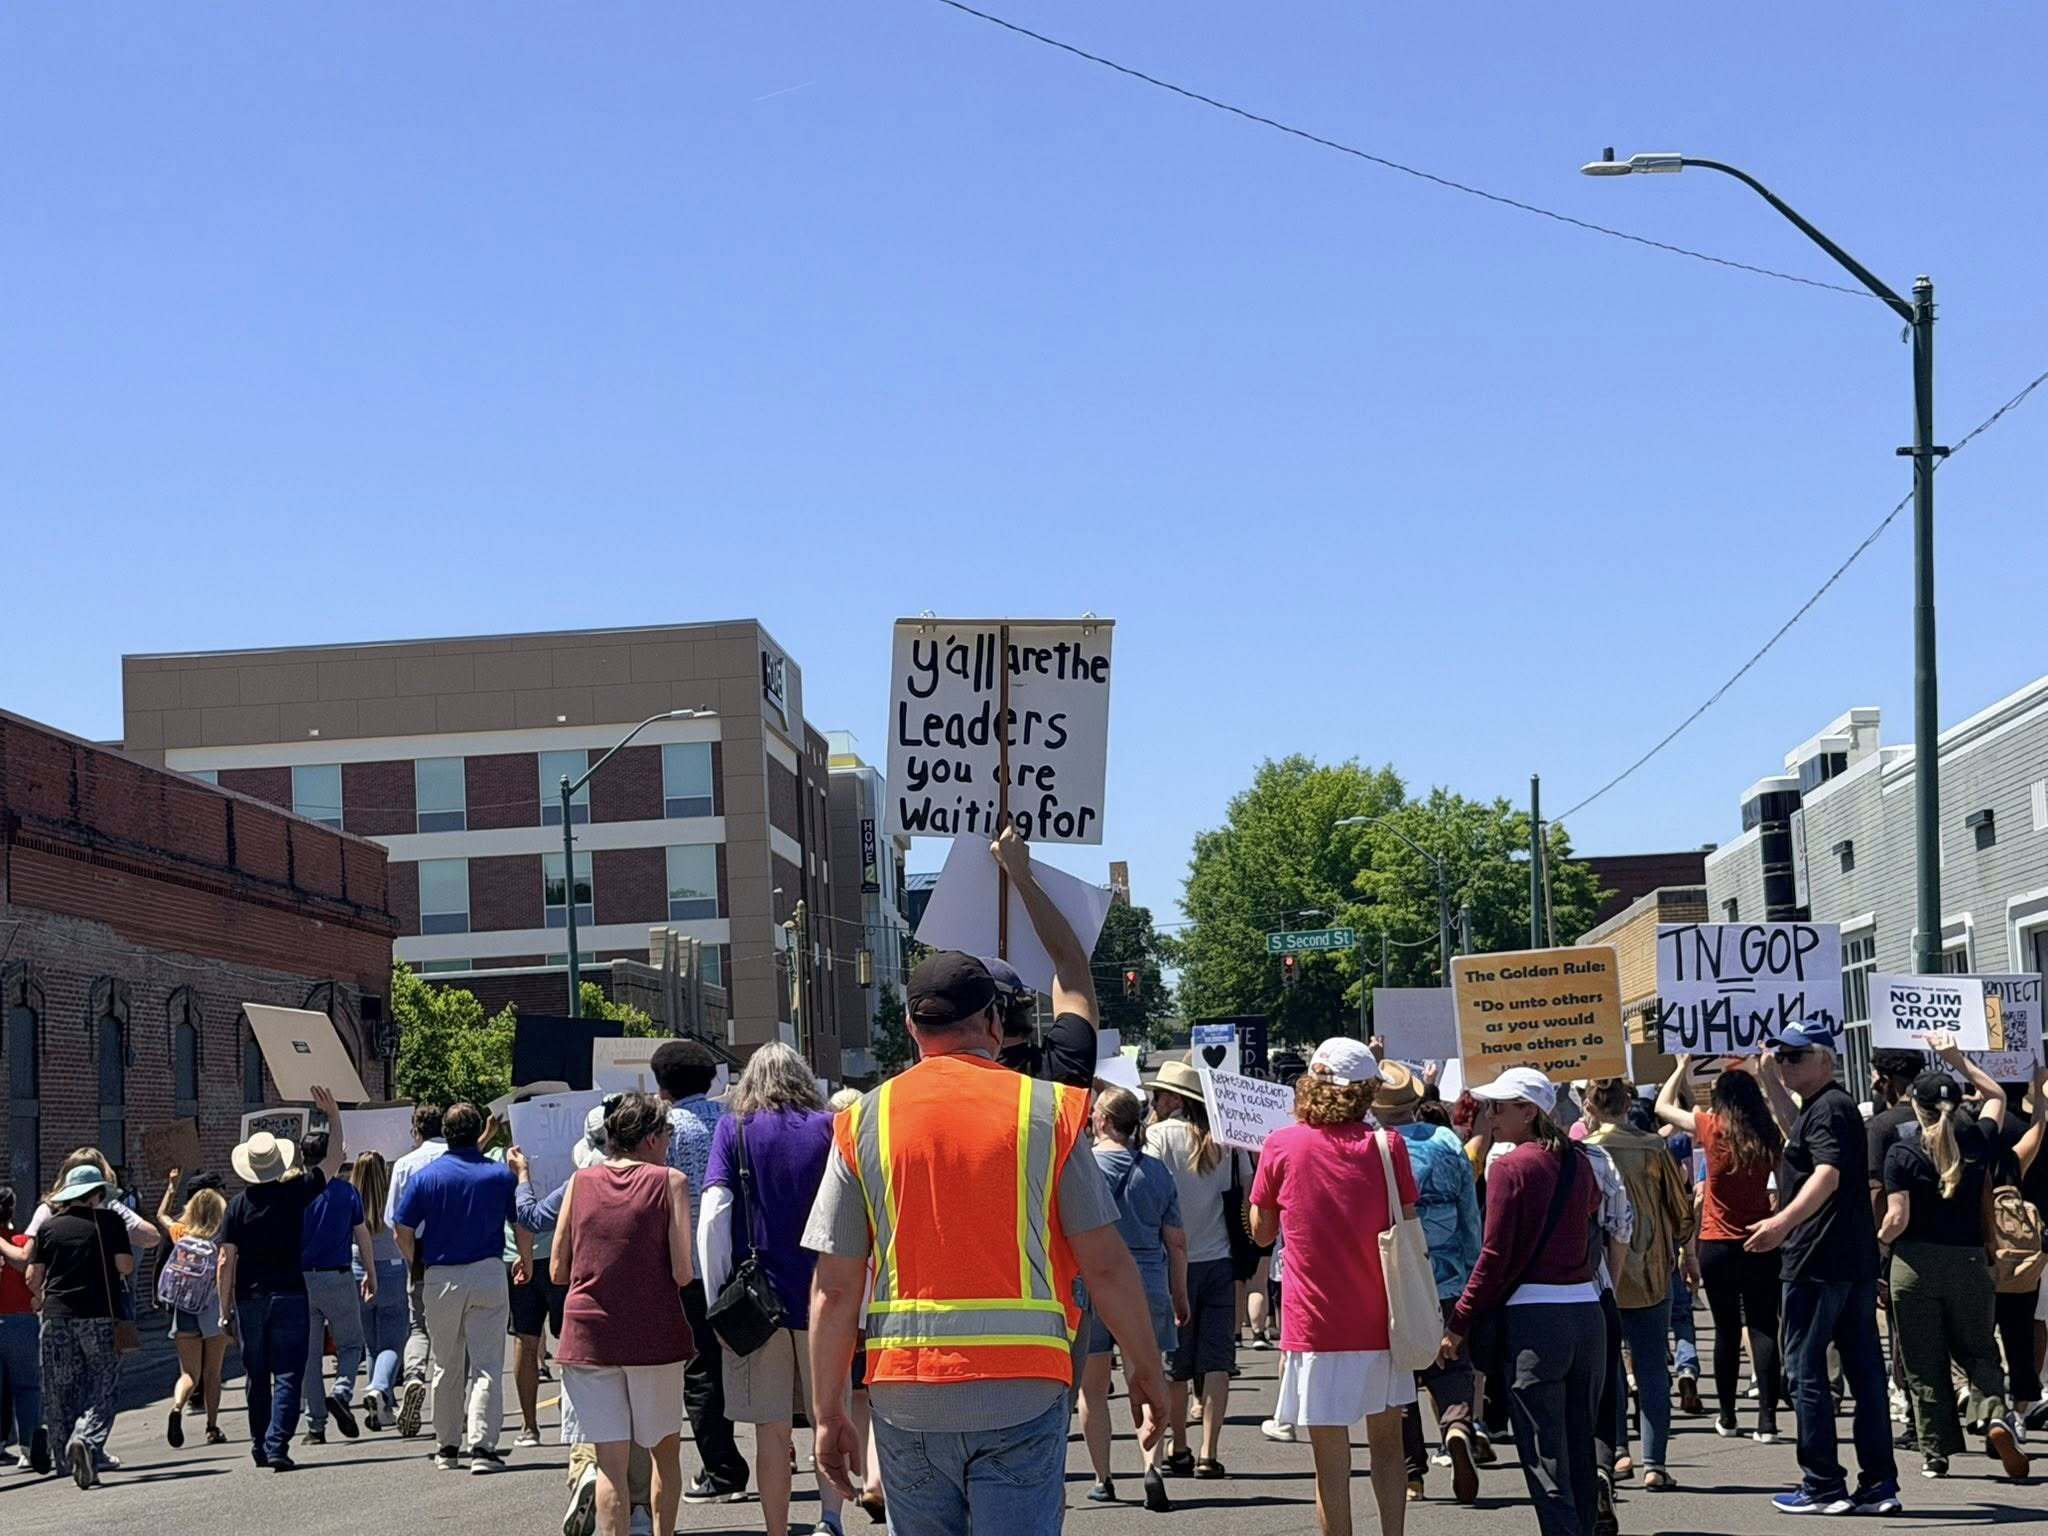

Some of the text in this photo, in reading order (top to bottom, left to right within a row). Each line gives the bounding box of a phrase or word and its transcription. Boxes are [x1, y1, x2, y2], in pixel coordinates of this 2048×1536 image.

[907, 633, 995, 698] y'all
[900, 700, 1068, 750] Leaders
[907, 756, 1056, 792] you are
[1038, 794, 1096, 838] for
[864, 820, 874, 863] HOME
[1272, 930, 1350, 950] S Second St
[1658, 924, 1820, 982] TN GOP
[1465, 961, 1606, 983] The Golden Rule:
[1509, 996, 1548, 1011] unto
[1552, 992, 1603, 1007] others
[1890, 990, 1962, 1006] NO JIM
[1486, 1012, 1595, 1033] as you would
[1892, 1004, 1961, 1018] CROW
[1896, 1018, 1961, 1032] MAPS
[1481, 1033, 1604, 1054] have others do
[1215, 1087, 1286, 1112] over racism!
[1216, 1102, 1264, 1127] Memphis
